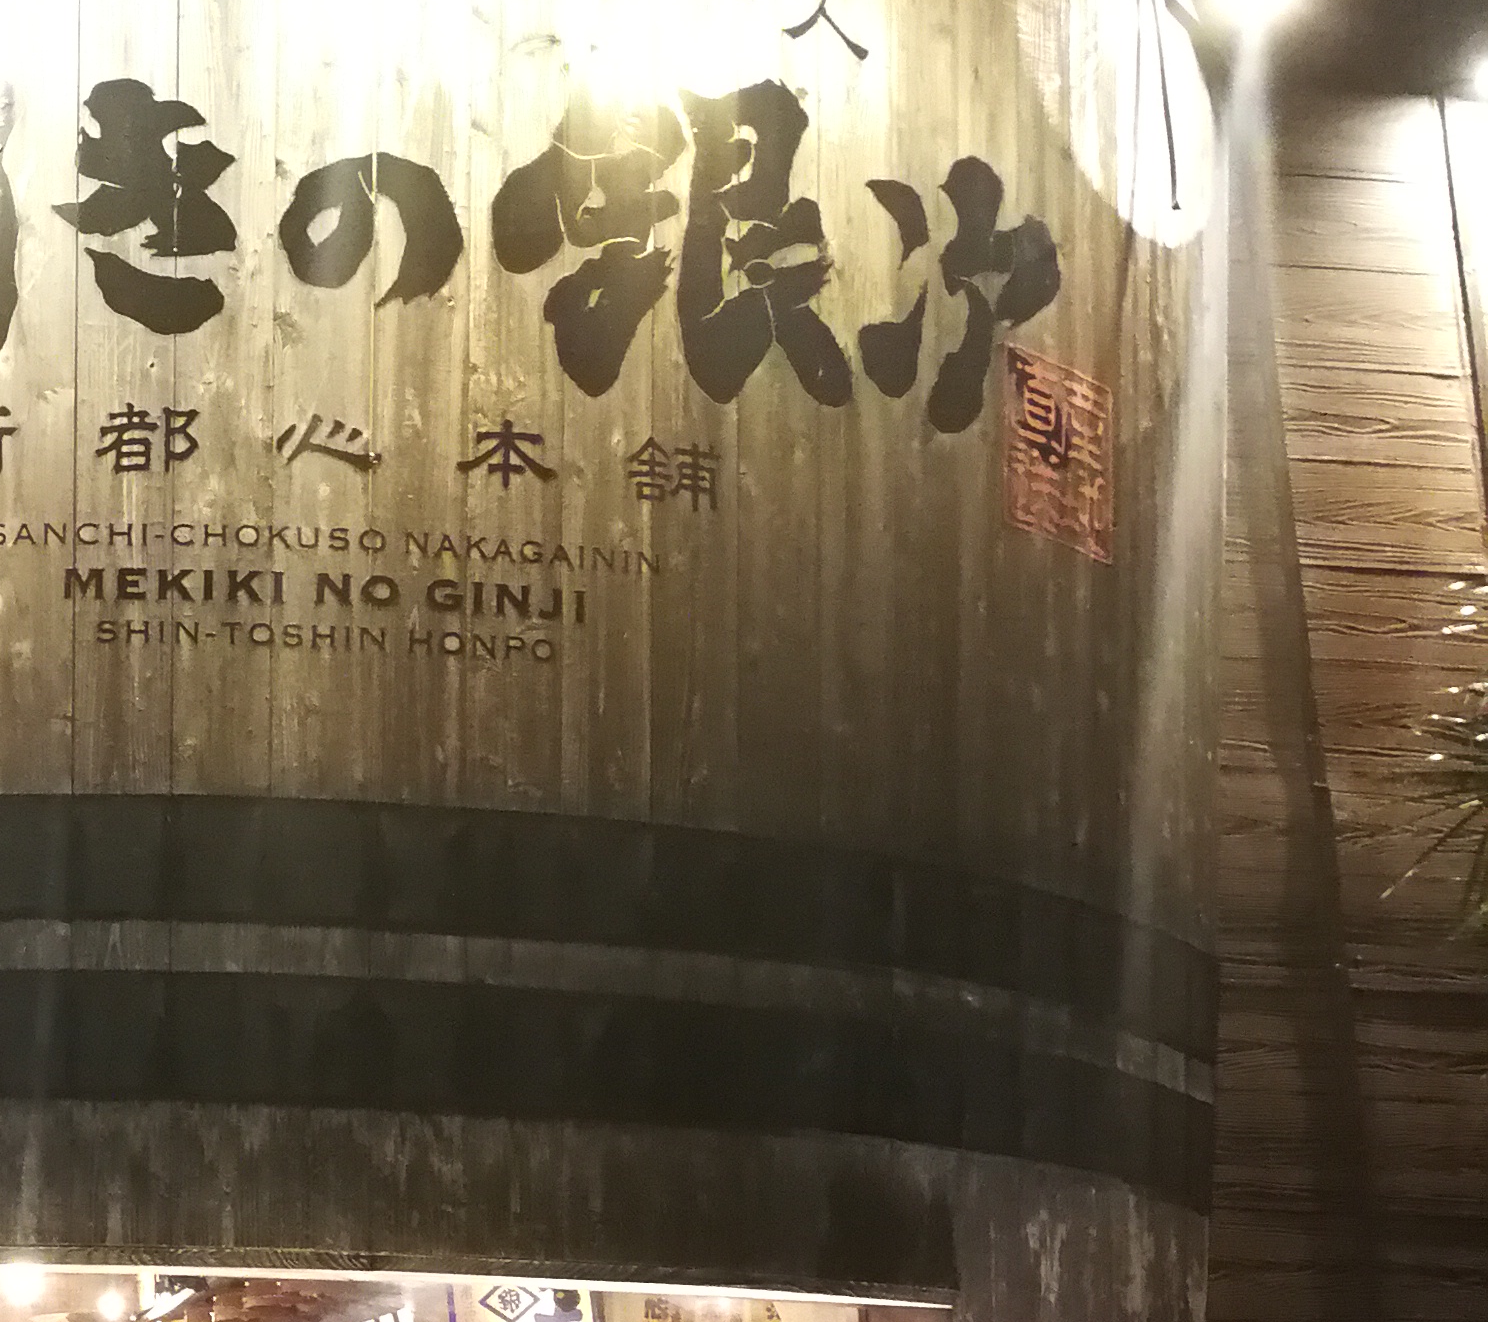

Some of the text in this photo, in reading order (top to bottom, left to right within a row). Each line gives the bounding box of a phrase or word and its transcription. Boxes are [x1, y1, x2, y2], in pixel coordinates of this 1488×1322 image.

[404, 532, 663, 576] NAKAGAININ
[64, 566, 588, 624] MEKIKI NO GINJI
[95, 619, 556, 663] SHIN-TOSHIN HONPO
